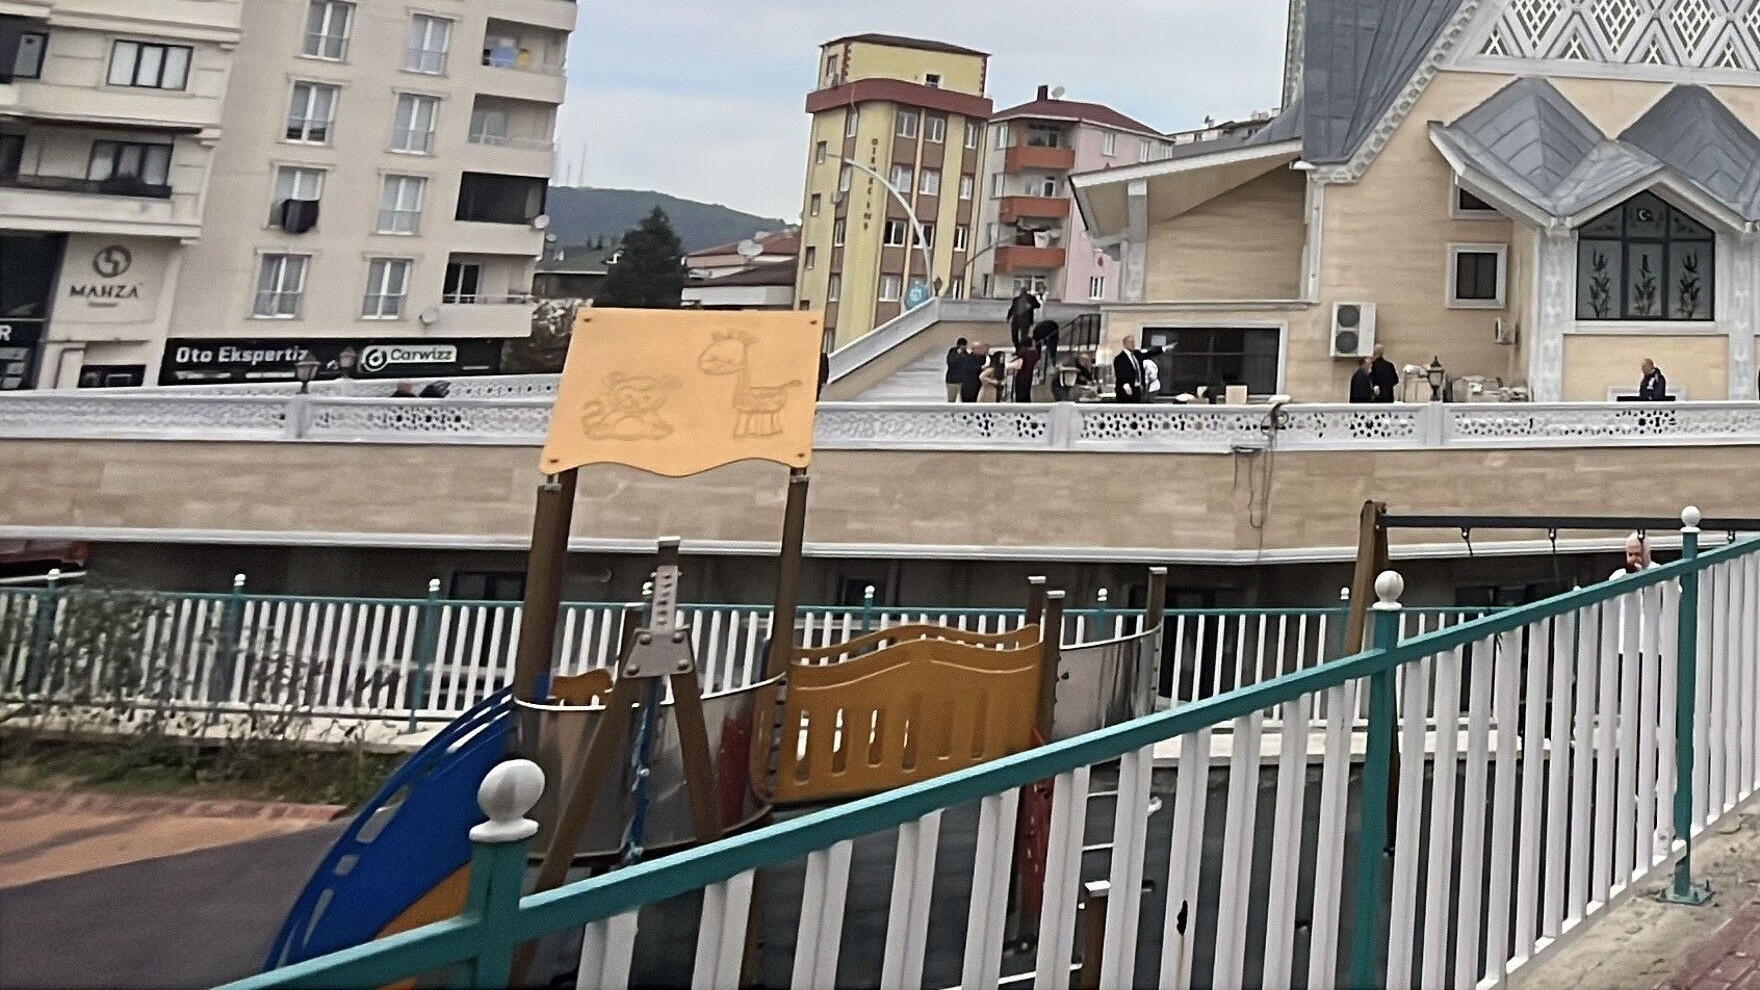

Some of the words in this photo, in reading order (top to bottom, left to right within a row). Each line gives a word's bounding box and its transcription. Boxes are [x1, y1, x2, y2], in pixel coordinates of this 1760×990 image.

[175, 346, 213, 363] Oto
[218, 345, 309, 366] Ekspertiz
[390, 347, 452, 361] Carwizz
